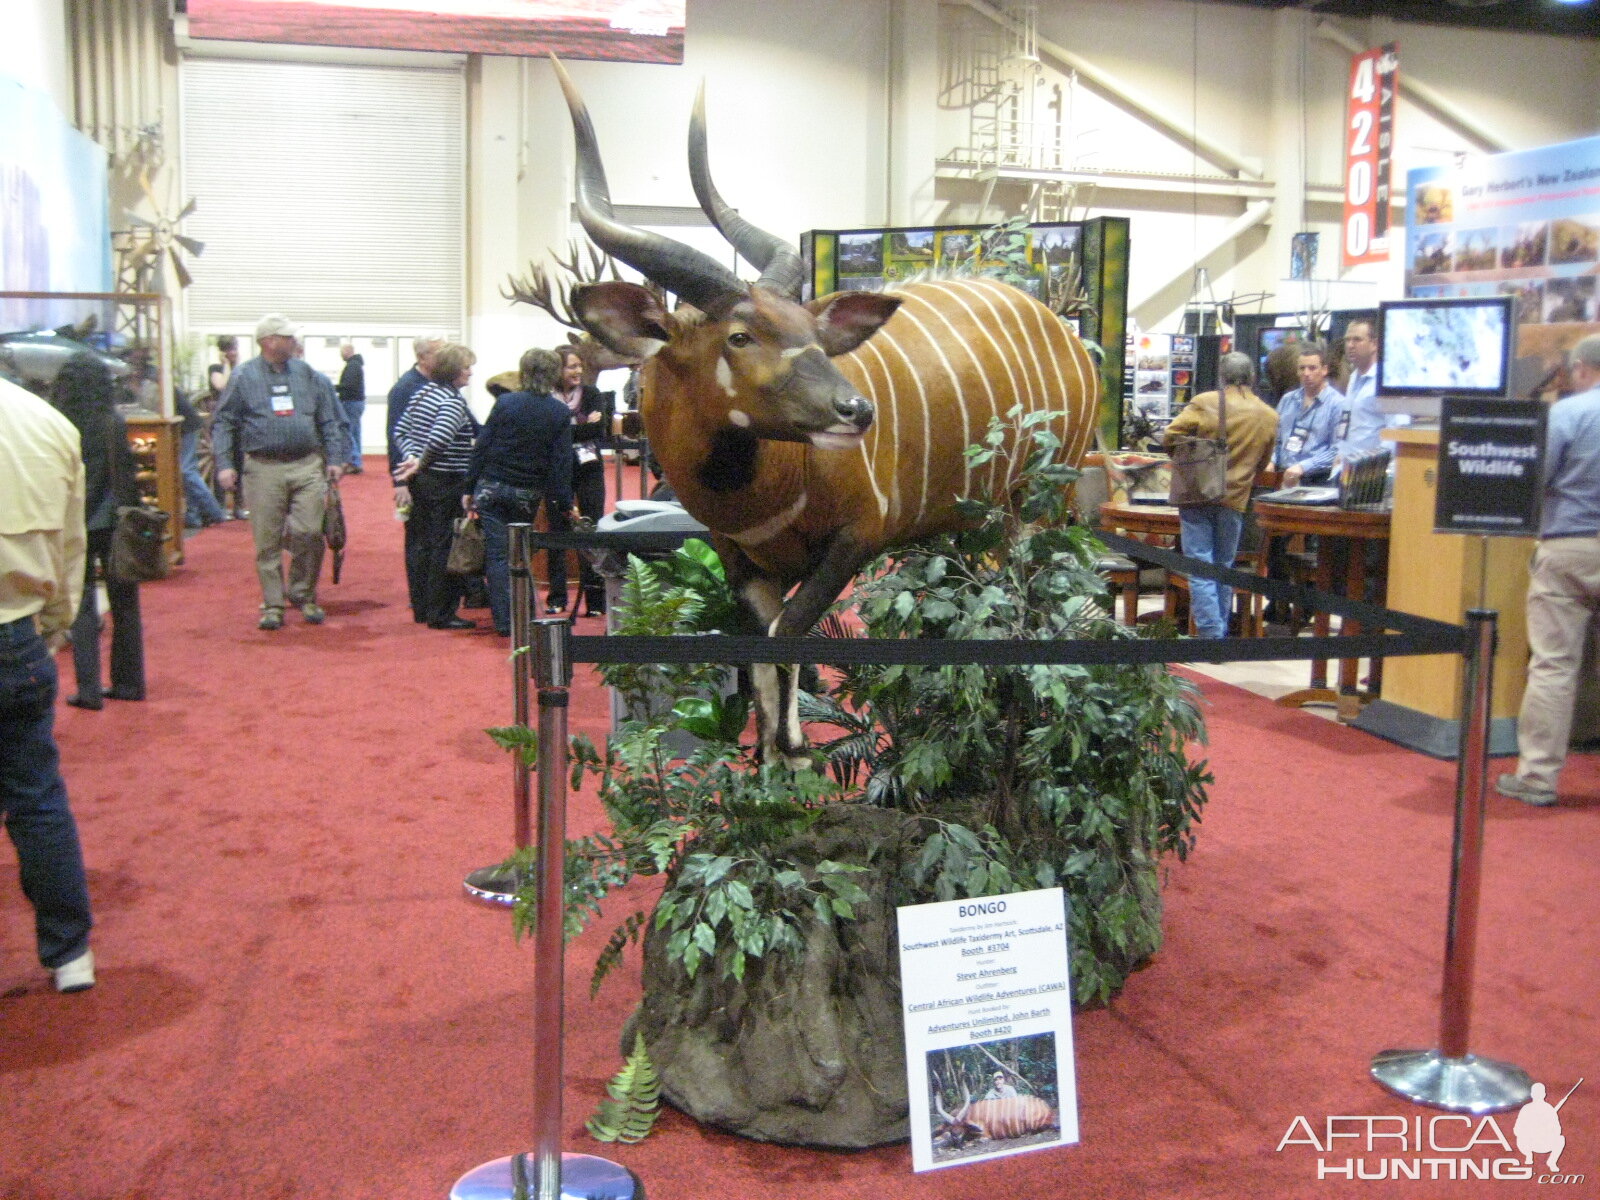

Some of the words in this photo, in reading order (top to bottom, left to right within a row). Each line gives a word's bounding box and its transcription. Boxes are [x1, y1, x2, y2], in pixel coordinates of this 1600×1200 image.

[1347, 57, 1375, 257] 4200
[1462, 186, 1483, 197] Gary
[1537, 174, 1559, 186] New
[1448, 441, 1537, 458] Southwest
[1459, 460, 1523, 476] Wildlife
[959, 901, 1007, 917] BONGO
[903, 940, 939, 951] Southwest
[941, 937, 967, 946] Wildlife
[969, 933, 1003, 944] Taxidermy
[961, 947, 984, 956] Booth
[987, 943, 1009, 952] #3704
[956, 972, 977, 981] Steve
[979, 966, 1017, 978] Ahrenberg
[908, 1002, 936, 1013] Central
[937, 998, 964, 1008] African
[965, 993, 994, 1003] Wildlife
[996, 987, 1037, 999] Adventures
[1039, 982, 1066, 993] (CAWA)
[928, 1021, 970, 1034] Adventures
[1012, 1011, 1029, 1021] John
[1031, 1008, 1051, 1018] Barth
[970, 1029, 992, 1039] Booth
[994, 1026, 1012, 1036] #420
